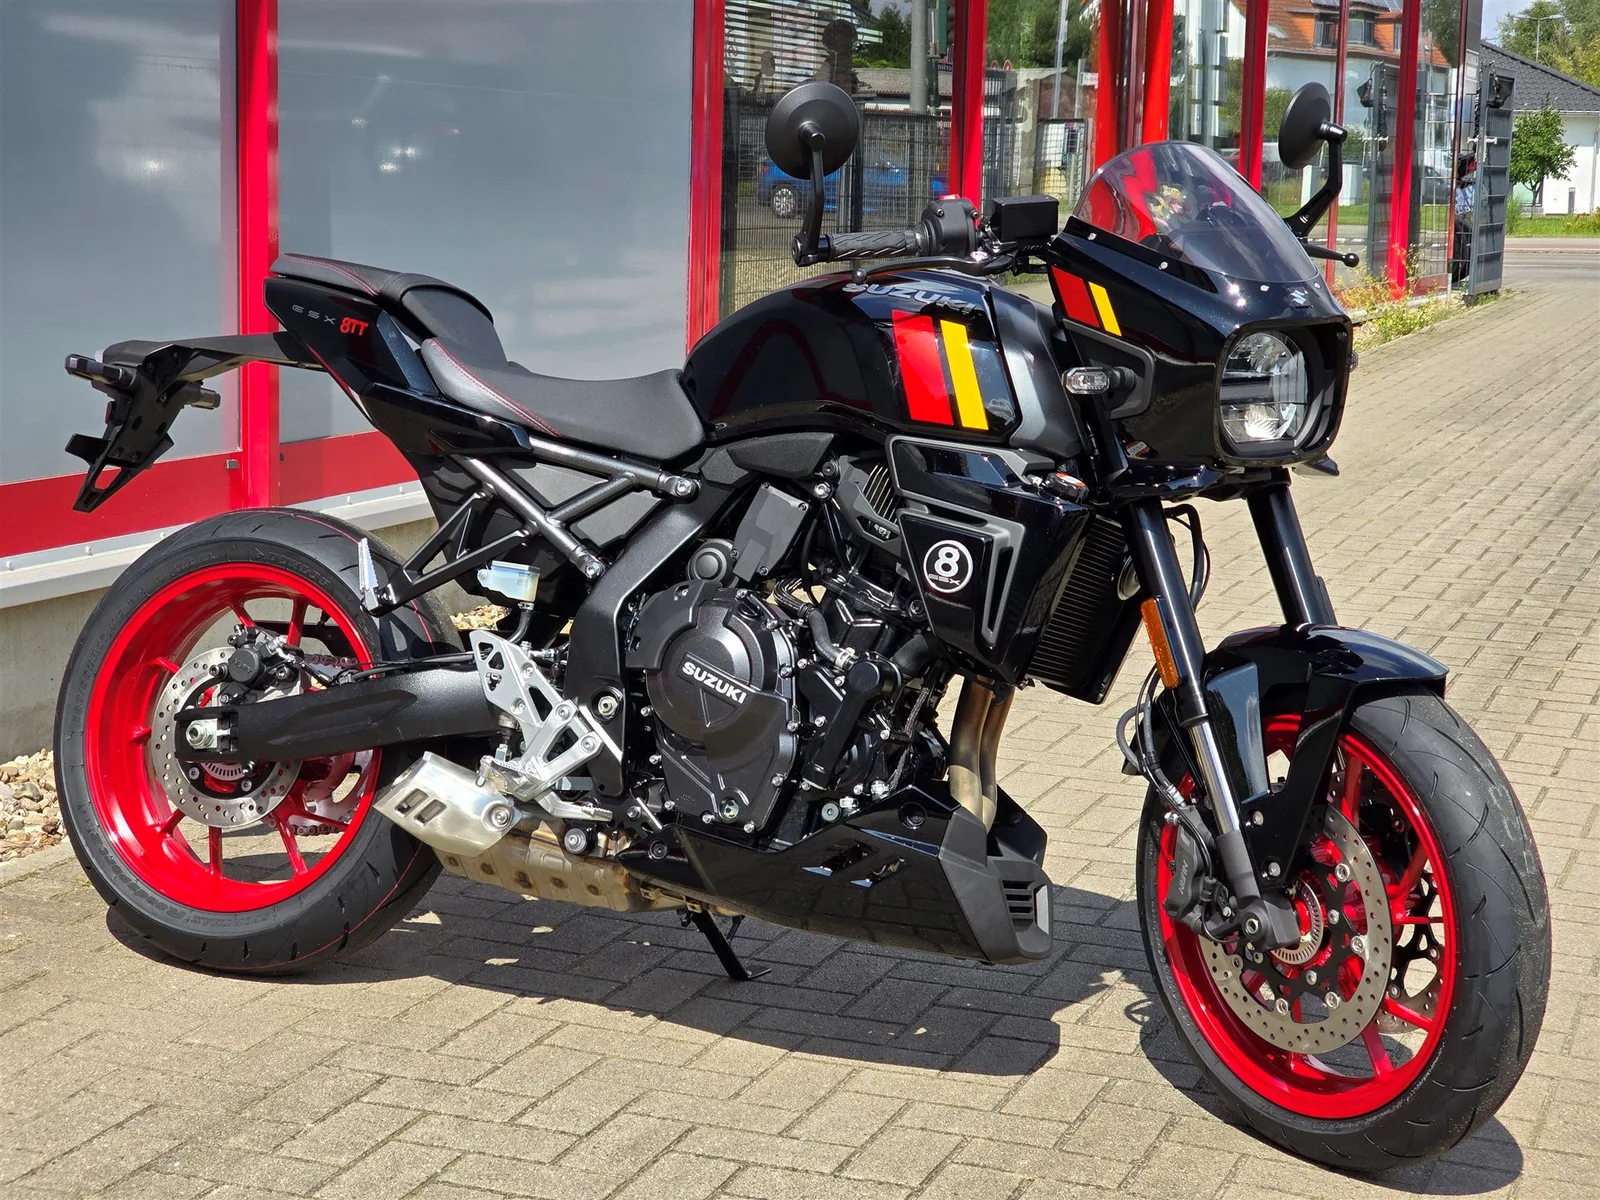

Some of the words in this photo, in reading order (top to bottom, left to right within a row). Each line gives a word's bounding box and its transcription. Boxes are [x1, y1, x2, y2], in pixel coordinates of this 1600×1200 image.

[292, 304, 336, 325] GSX
[340, 317, 369, 336] 8TT
[934, 546, 960, 578] 8
[682, 661, 747, 704] SUZUKI
